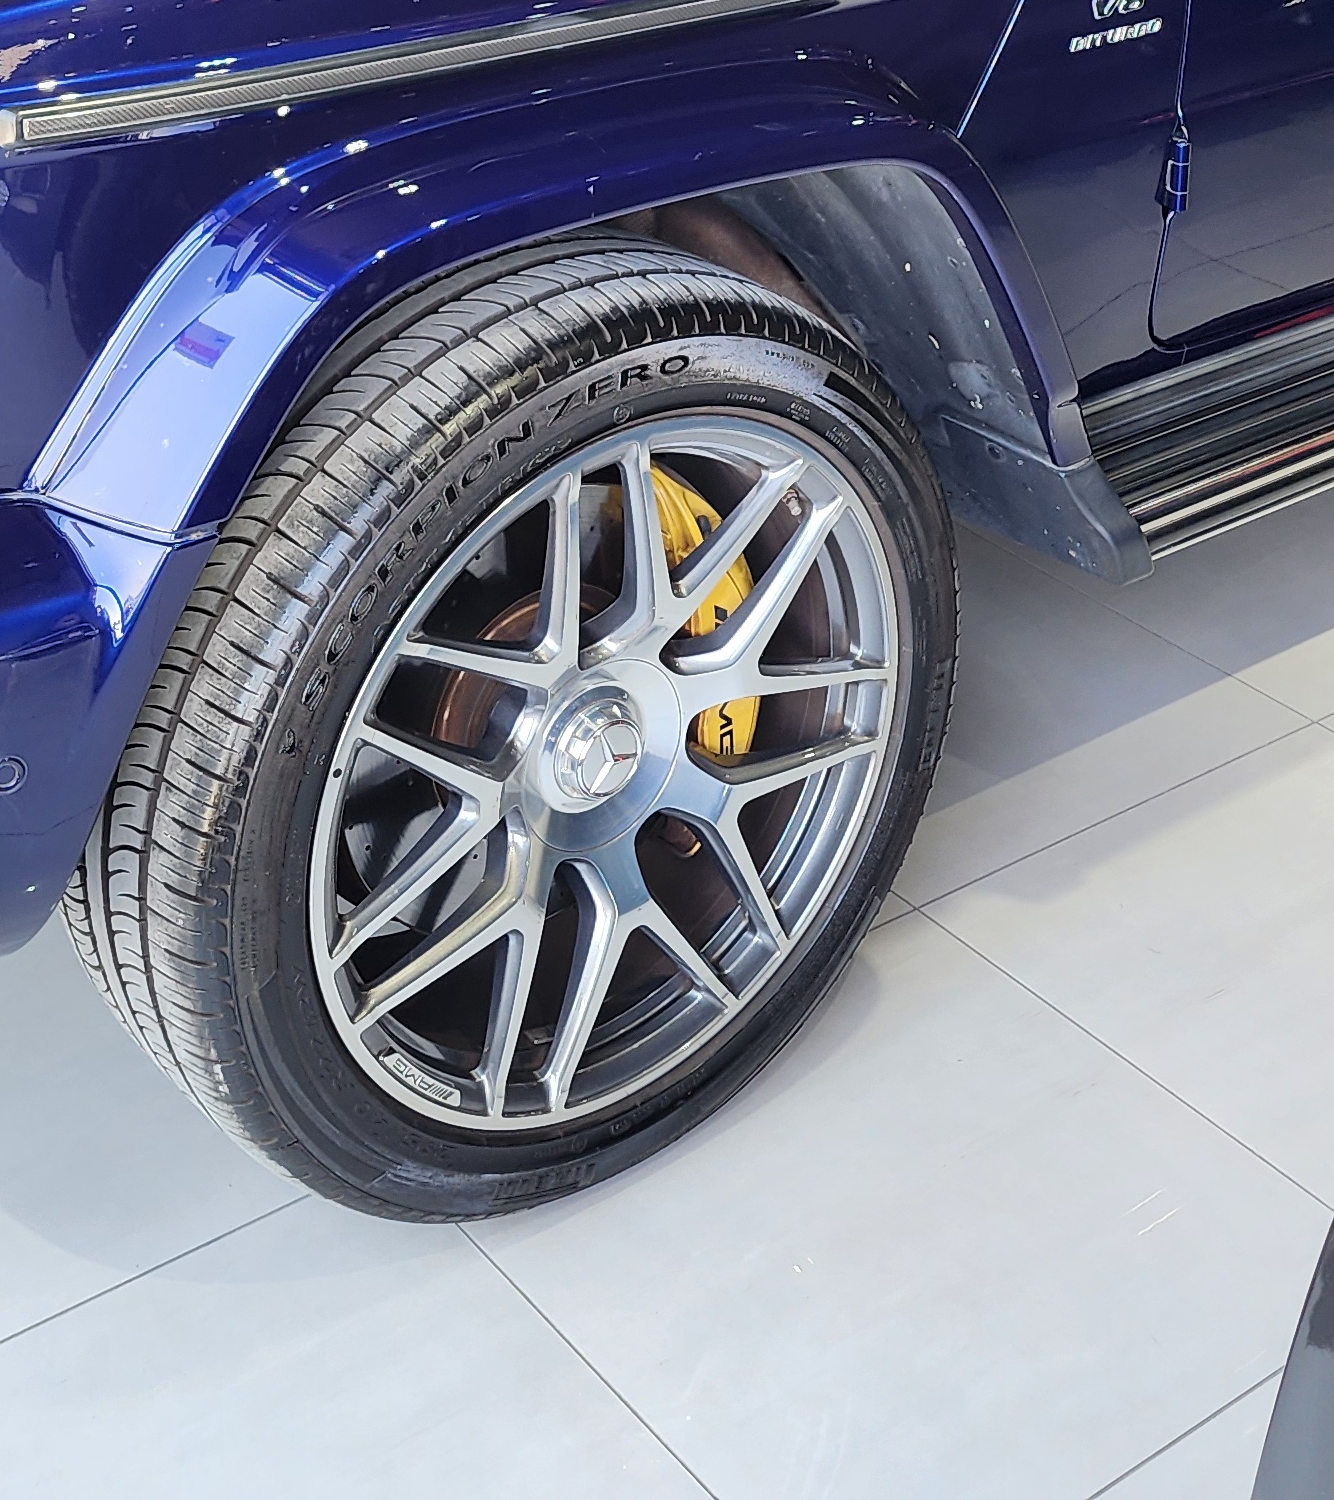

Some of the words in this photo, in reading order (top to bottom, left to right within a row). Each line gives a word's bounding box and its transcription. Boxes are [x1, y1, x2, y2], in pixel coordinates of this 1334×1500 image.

[300, 418, 536, 713] SCORPION
[545, 353, 691, 429] ZERO
[392, 1057, 433, 1094] AMG
